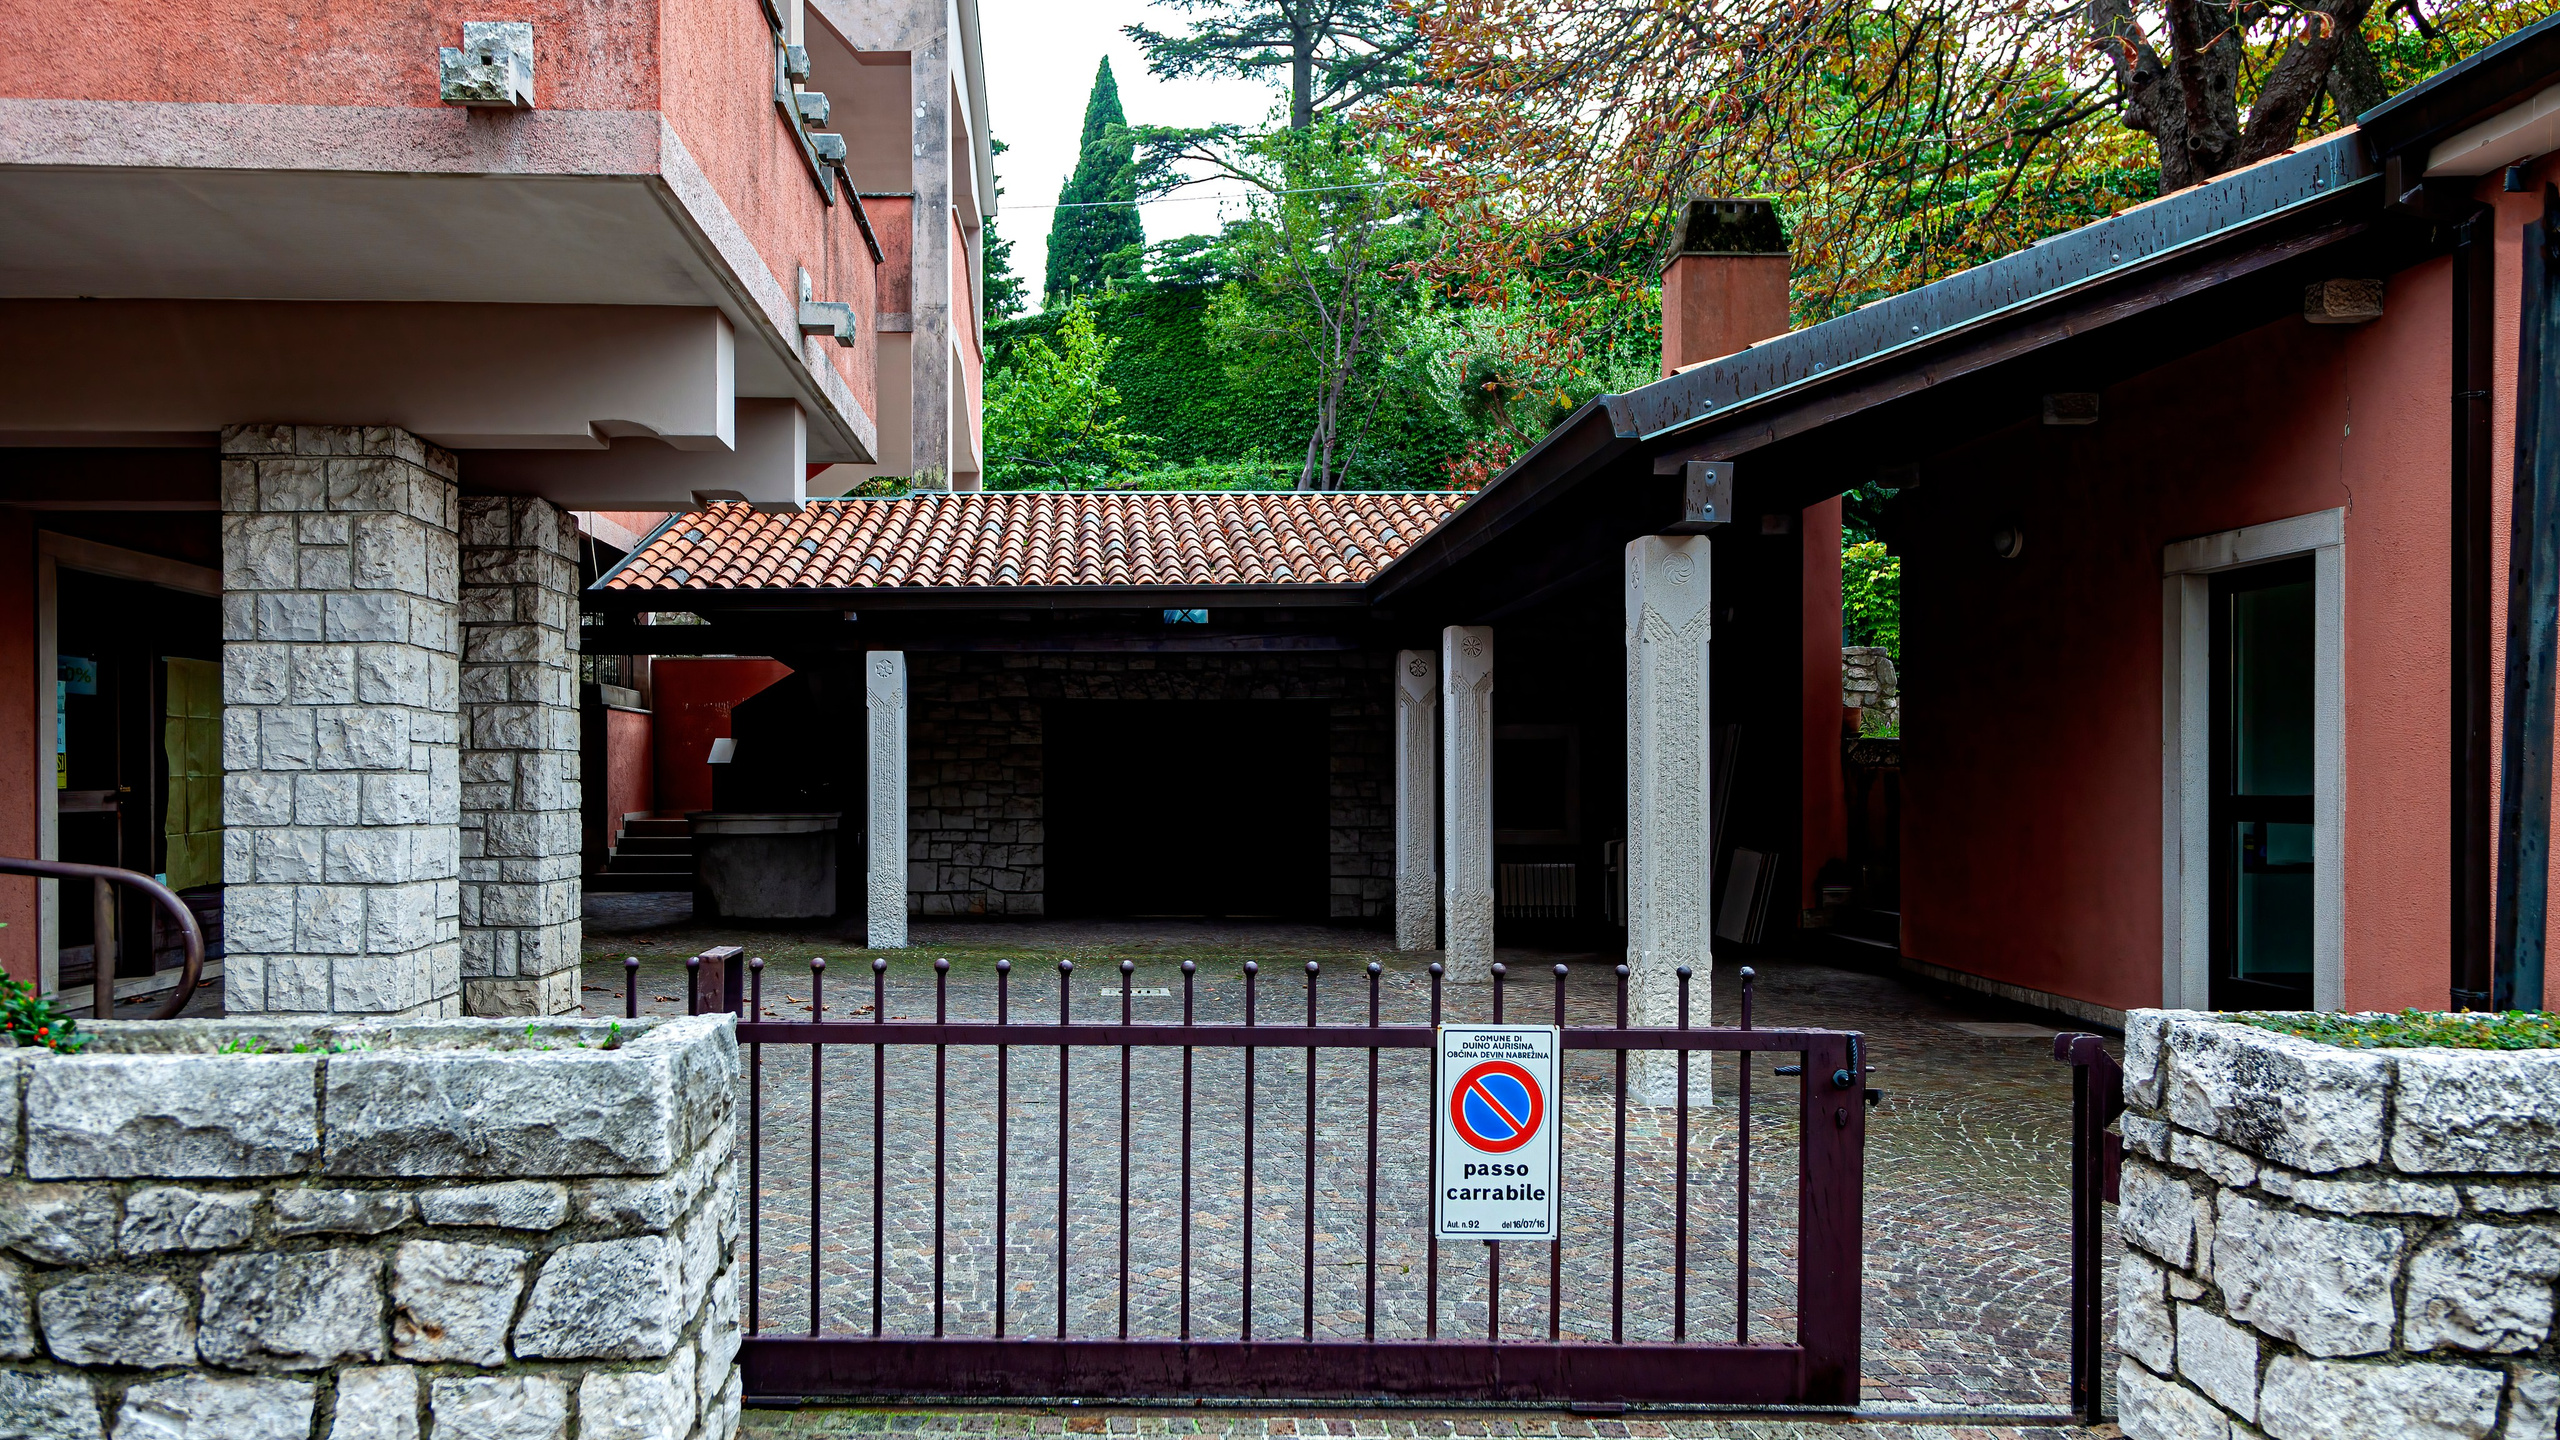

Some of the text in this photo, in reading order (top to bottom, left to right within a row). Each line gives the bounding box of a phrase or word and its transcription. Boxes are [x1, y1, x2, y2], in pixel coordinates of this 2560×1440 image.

[1447, 1050, 1549, 1059] OBČINA DEVIN NABREŽINA
[1464, 1163, 1529, 1179] passo
[1446, 1184, 1546, 1201] carrabile
[1447, 1220, 1459, 1228] Aut.
[1501, 1221, 1512, 1229] del
